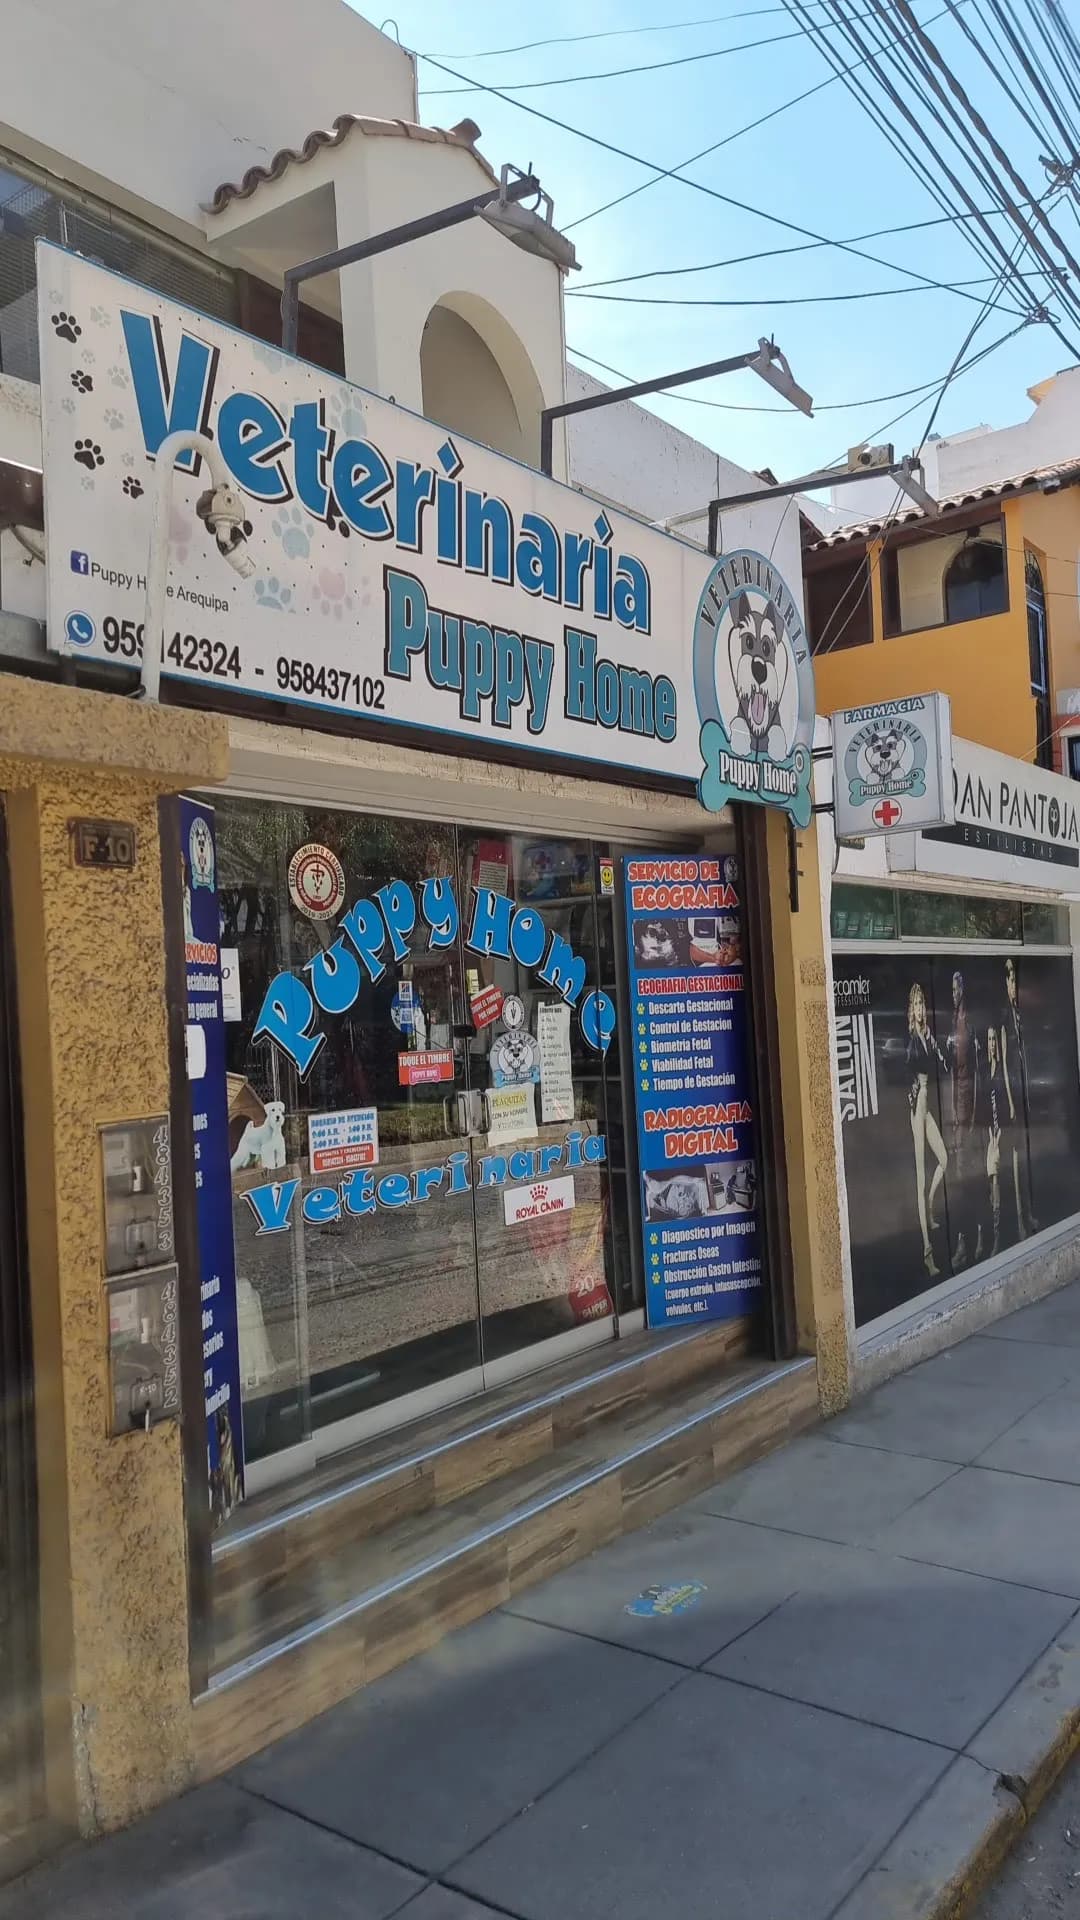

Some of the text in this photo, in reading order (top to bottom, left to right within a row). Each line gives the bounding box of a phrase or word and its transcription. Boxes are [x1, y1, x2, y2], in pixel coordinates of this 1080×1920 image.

[120, 309, 651, 635] Veterinaria
[91, 562, 229, 612] Puppy He Arequipa
[701, 556, 807, 666] VETERINARIA
[383, 565, 677, 743] Puppy Home
[276, 657, 385, 709] 958437102
[844, 697, 925, 724] FARMACIA
[719, 750, 798, 796] Puppy Home
[628, 859, 720, 883] SERVICIO DE
[632, 883, 740, 911] ECOGRAFIA
[251, 876, 459, 1084] Puppy
[464, 886, 616, 1056] Home
[637, 976, 687, 996] ECOGRAFIA
[648, 997, 734, 1015] Descarte Gestacional
[649, 1020, 680, 1035] Control
[680, 1019, 692, 1033] de
[691, 1036, 712, 1051] Fetal
[651, 1055, 714, 1073] Viabilidad Fetal
[652, 1076, 683, 1092] Tiempo
[684, 1075, 695, 1089] de
[643, 1100, 752, 1132] RADIOGRAFIA
[664, 1127, 738, 1158] DIGITAL
[239, 1130, 608, 1237] Veterinaria
[515, 1198, 564, 1219] ROYAL CANIN
[711, 1224, 726, 1239] por
[663, 1249, 697, 1264] Fracturas
